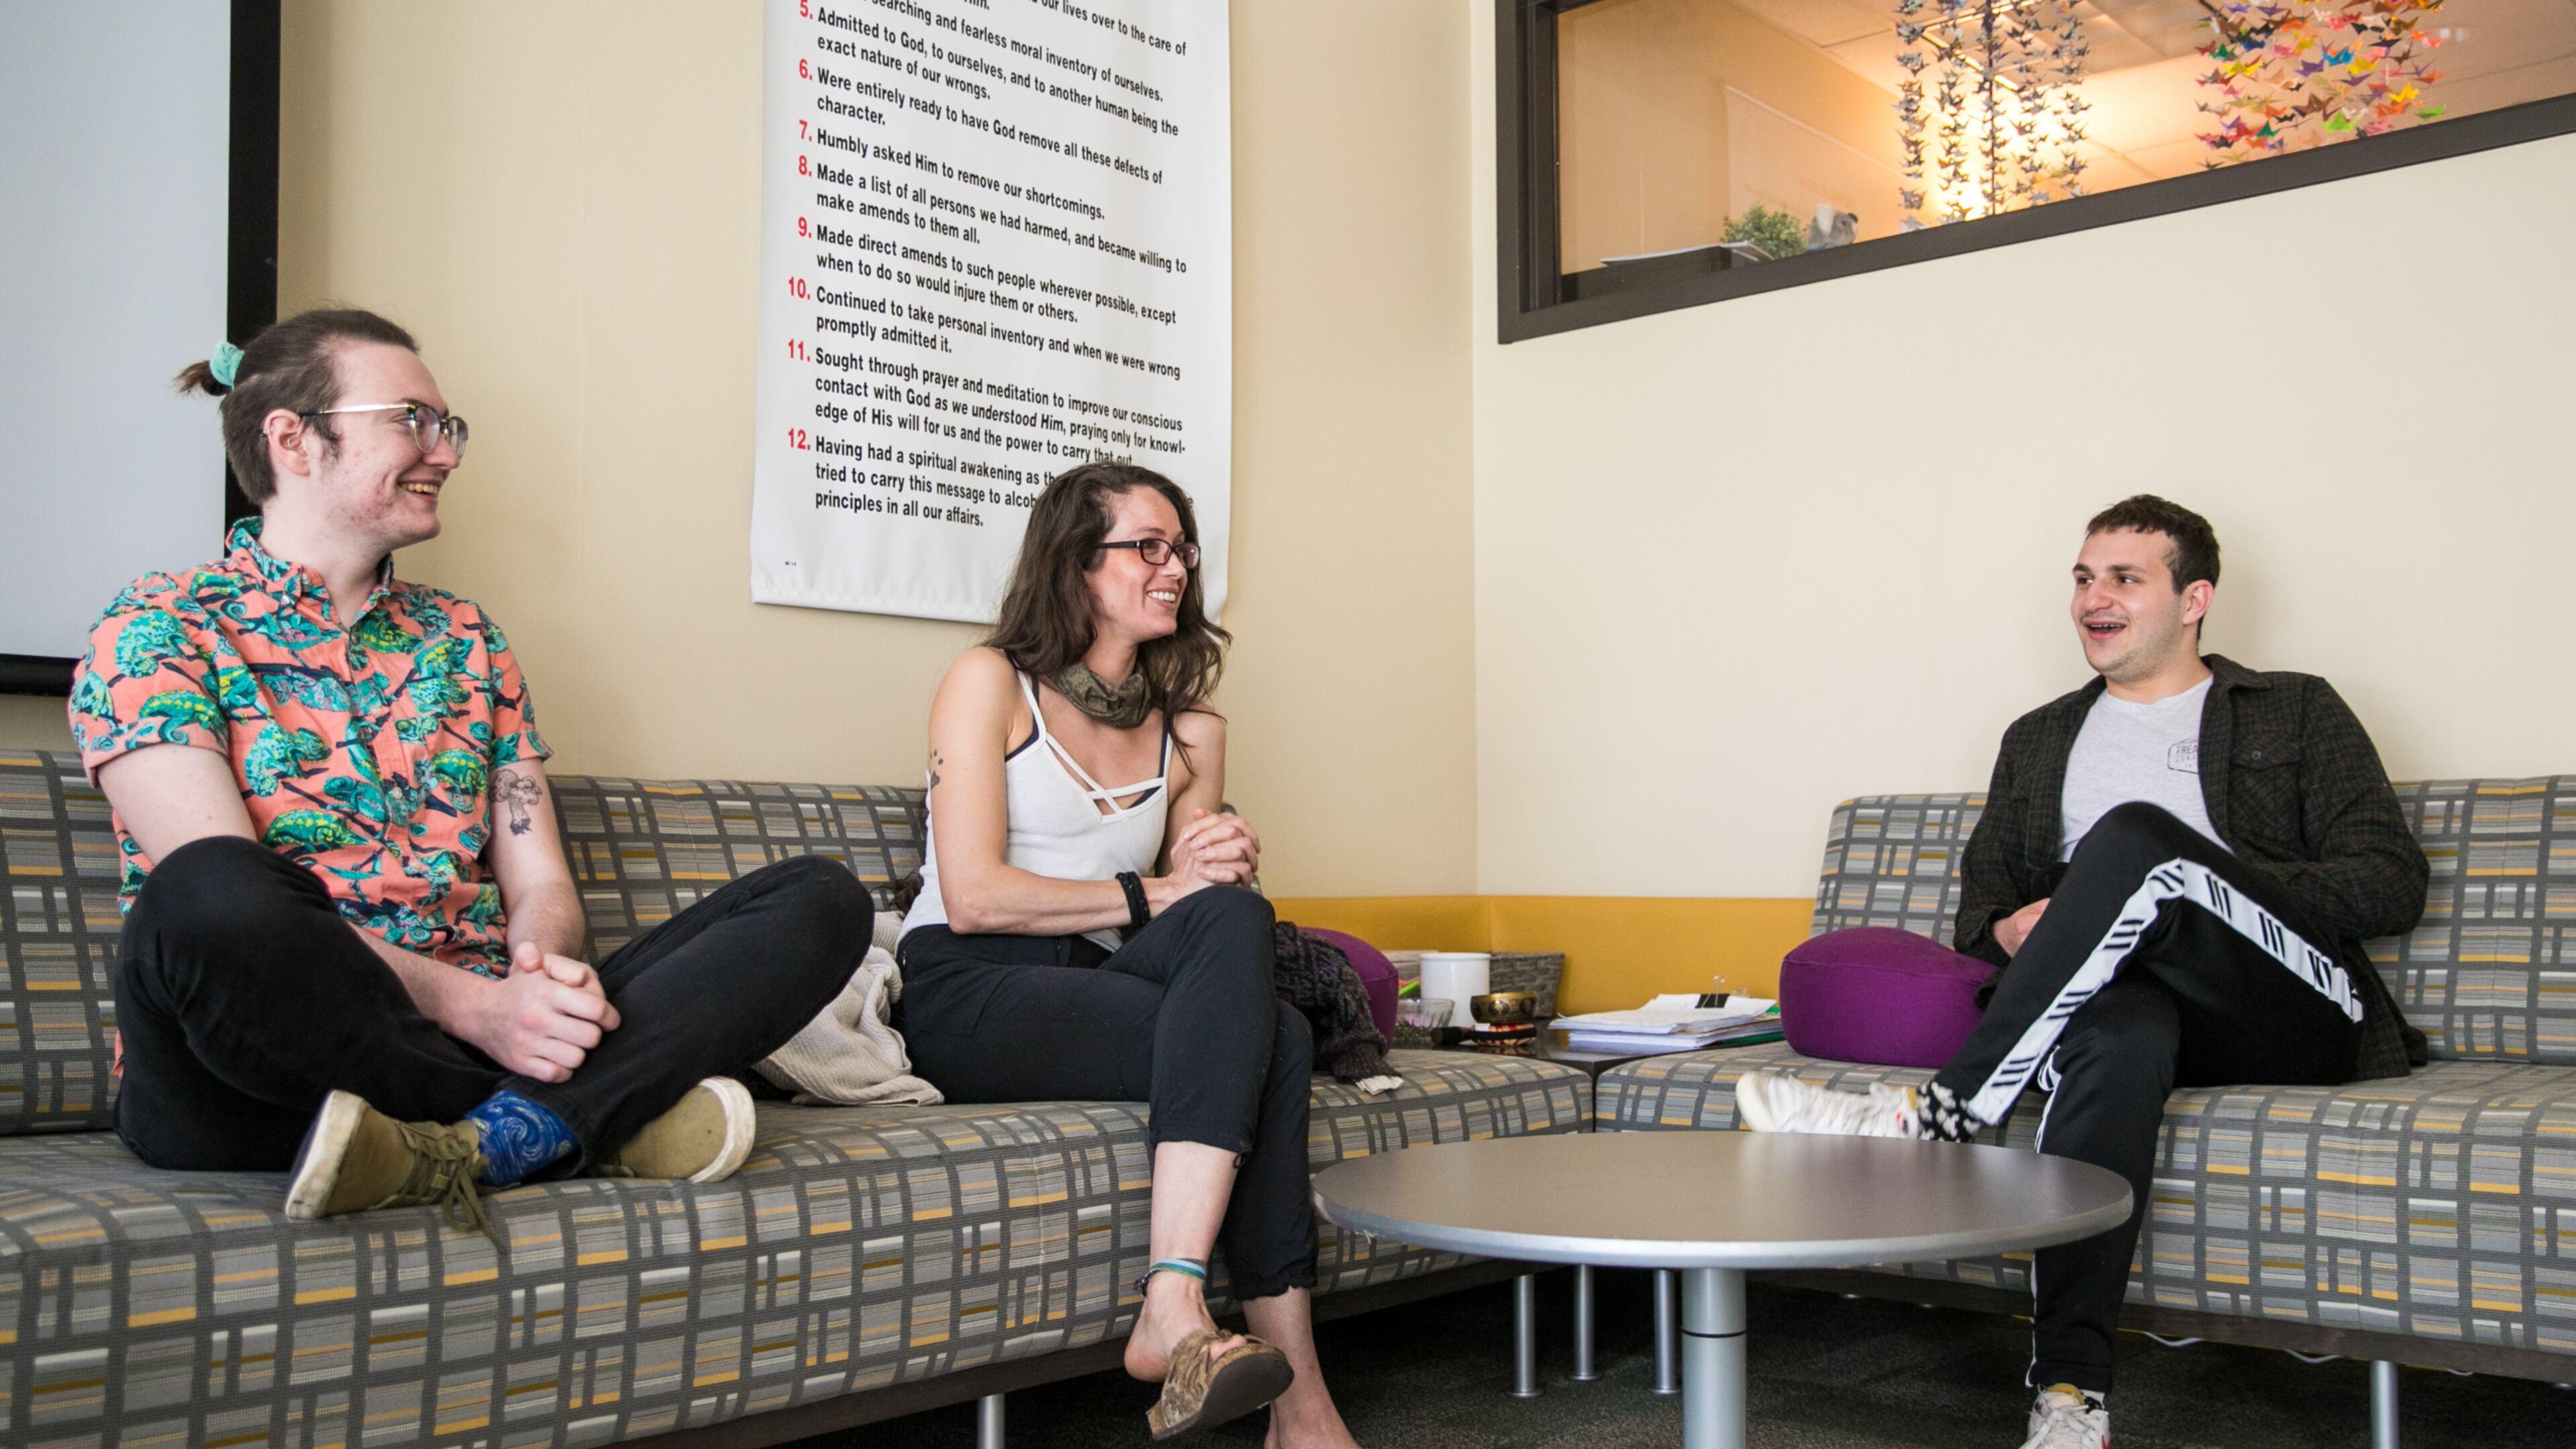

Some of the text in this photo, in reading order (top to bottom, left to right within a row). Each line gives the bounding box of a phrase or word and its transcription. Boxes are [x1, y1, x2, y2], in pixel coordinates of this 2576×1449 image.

[936, 14, 1163, 102] and fearless moral inventory of ourselves.
[1063, 0, 1186, 56] lives over to the care of
[818, 36, 990, 99] exact nature of our wrongs.
[818, 7, 1179, 136] Admitted to God, to ourselves, and to another human being the
[799, 58, 1163, 184] 6. Were entirely ready to have God remove all these defects of
[817, 95, 885, 125] character.
[799, 119, 1104, 220] 7. Humbly asked Him to remove our shortcomings.
[798, 155, 1186, 273] 8. Made list of all persons we had harmed, and became willing to
[817, 193, 980, 244] make amends to them all.
[798, 217, 1176, 325] 9. Made direct amends to such people wherever possible, except
[816, 253, 1077, 323] when to do so would injure them others.
[788, 276, 1180, 380] 10. Continued to take personal inventory and when we were wrong
[816, 316, 951, 354] promptly admitted it.
[788, 339, 1182, 431] 11. Sought through prayer and meditation to improve our conscious
[816, 378, 1185, 453] contact with God as we understood Him, praying only for knowl-
[788, 428, 1040, 486] 12. Having had spiritual awakening as
[816, 402, 1091, 464] edge of His will for us and the power to carry
[816, 463, 846, 482] tried
[851, 468, 865, 484] to
[871, 473, 905, 492] carry
[909, 475, 932, 493] this
[936, 482, 985, 504] message
[989, 488, 1000, 504] to
[816, 490, 983, 527] principles in all our affairs.
